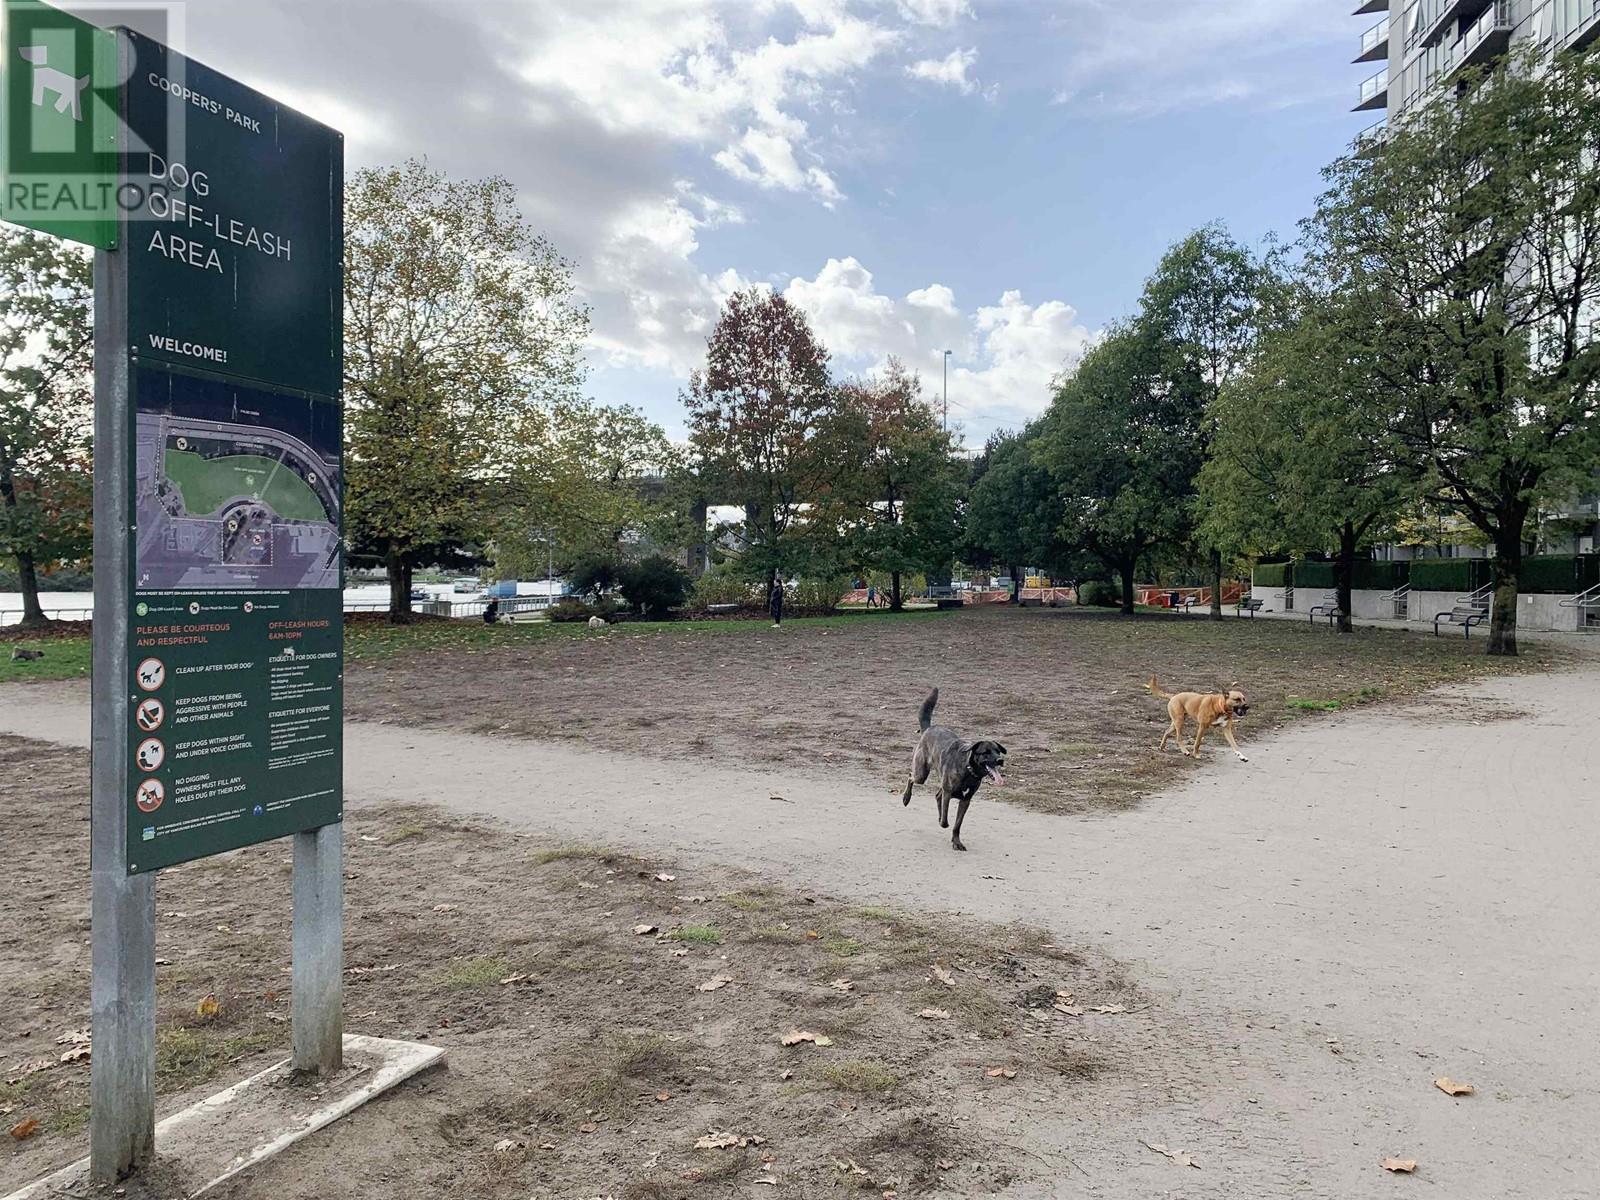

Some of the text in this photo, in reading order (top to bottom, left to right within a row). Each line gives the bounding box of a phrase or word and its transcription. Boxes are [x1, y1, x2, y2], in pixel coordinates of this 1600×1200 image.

[149, 72, 261, 134] COOPERS' PARK
[149, 152, 210, 197] DOG
[148, 192, 291, 261] OFF-LEASH
[148, 230, 224, 274] AREA
[149, 334, 228, 363] WELCOME!
[136, 626, 168, 634] PLEASE
[184, 624, 231, 632] COURTEOUS
[136, 636, 208, 647] AND RESPECTFUL
[176, 705, 211, 714] AGGRESSIVE
[268, 709, 294, 718] ETIQUETTE
[306, 705, 330, 713] EVERYONE
[190, 714, 208, 722] OTHER
[210, 711, 234, 719] ANIMALS
[190, 748, 209, 756] UNDER
[228, 742, 253, 750] CONTROL
[186, 773, 210, 783] DIGGING
[175, 784, 200, 794] OWNERS
[202, 781, 216, 789] MUST
[175, 795, 194, 804] HOLES
